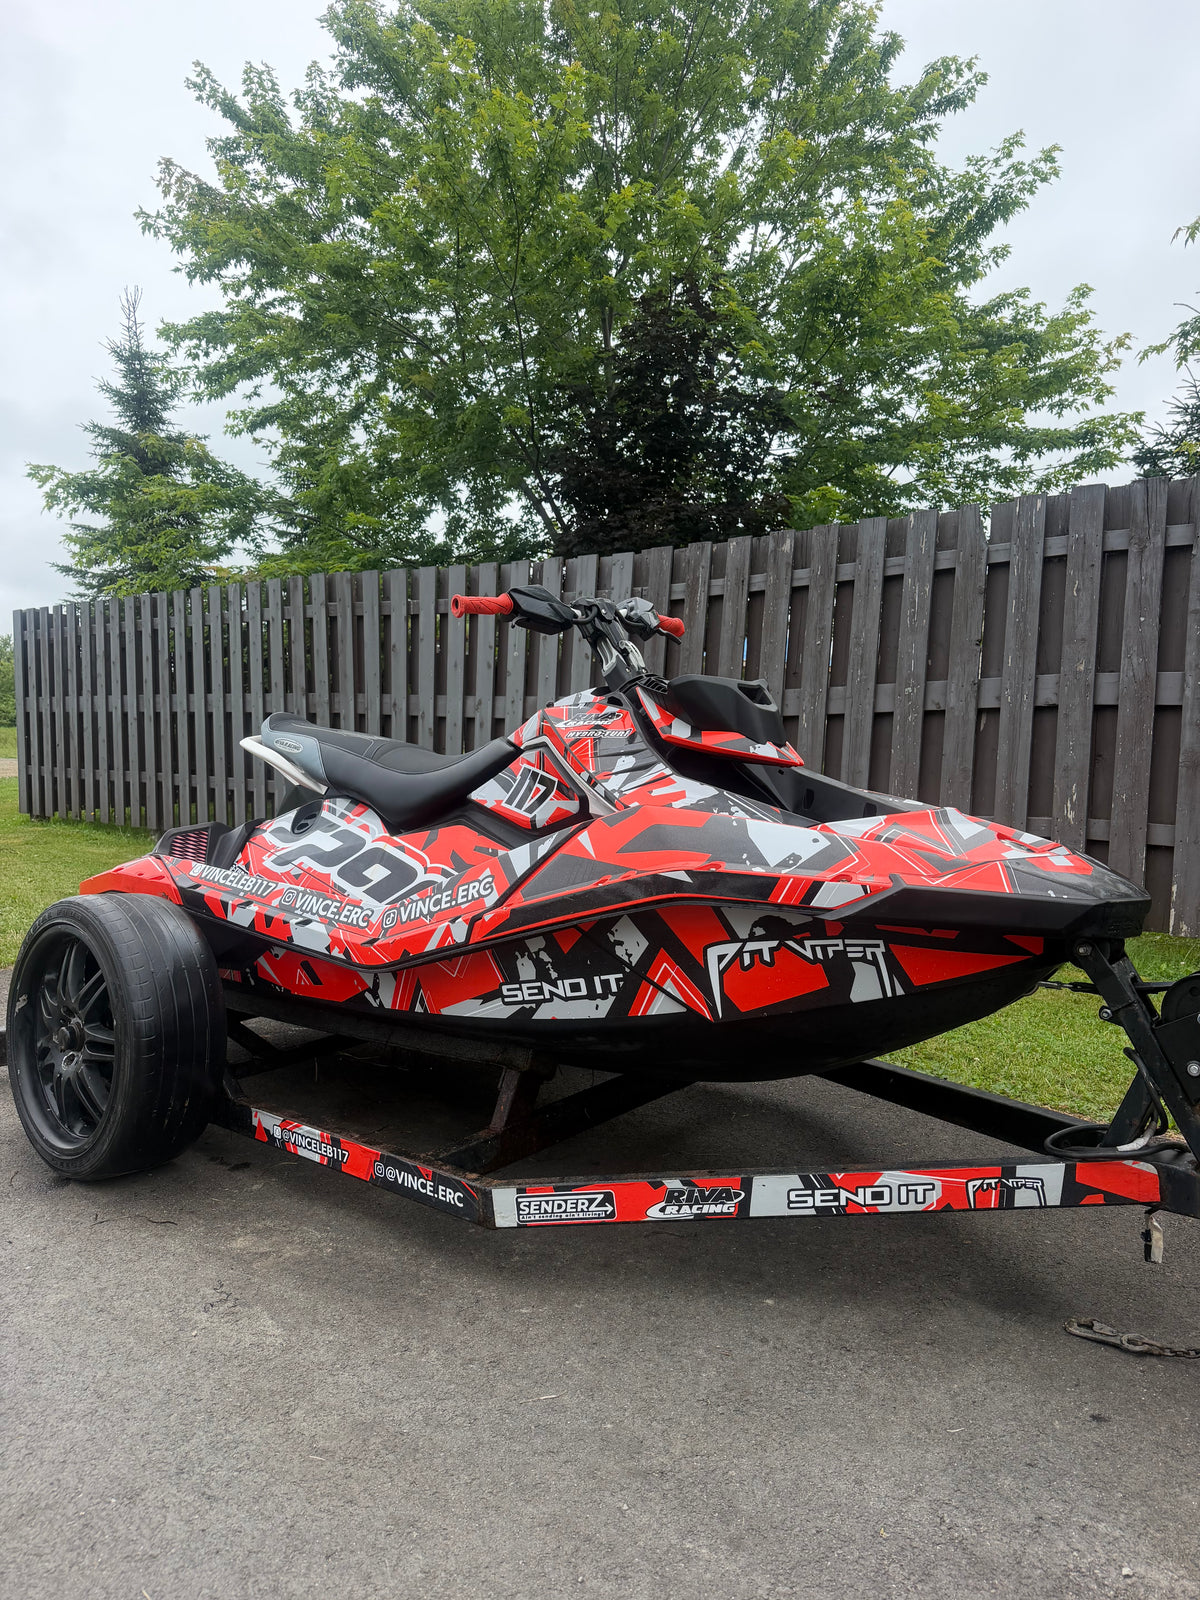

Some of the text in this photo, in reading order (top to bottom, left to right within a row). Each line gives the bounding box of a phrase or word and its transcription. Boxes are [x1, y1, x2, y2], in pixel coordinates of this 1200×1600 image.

[294, 892, 372, 927] VINCE.ERC
[400, 877, 493, 922] VINCE.ERC
[502, 973, 623, 1002] SEND IT
[707, 939, 892, 1019] PIT VIPER
[281, 1129, 349, 1163] @VINCELEB117
[385, 1166, 464, 1207] @VINCE.ERC
[664, 1187, 735, 1204] RIVA
[789, 1184, 933, 1208] SEND IT
[967, 1178, 1045, 1208] PIT VIPER
[519, 1194, 611, 1214] SENDERZ
[664, 1203, 735, 1215] RACING
